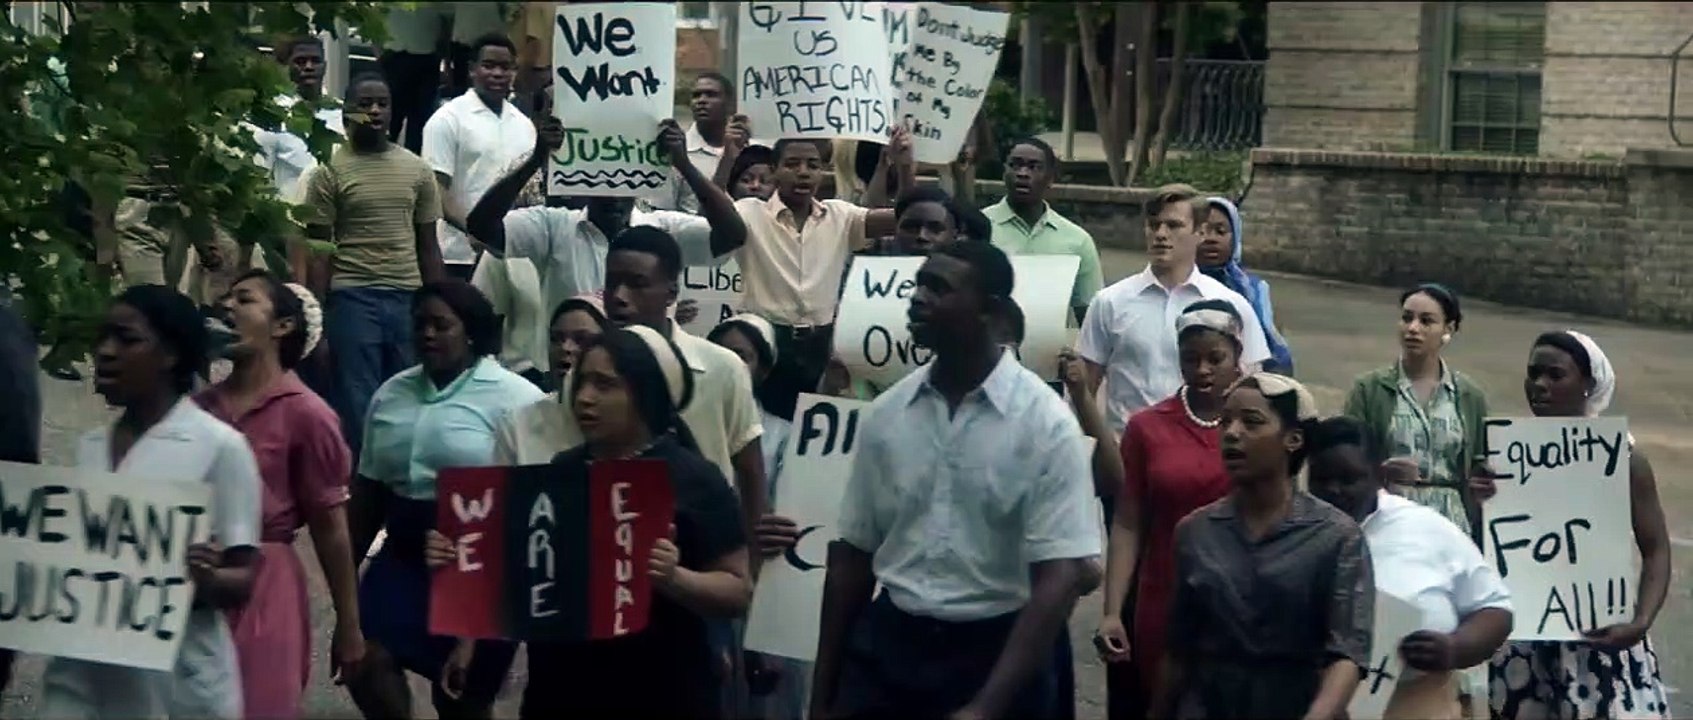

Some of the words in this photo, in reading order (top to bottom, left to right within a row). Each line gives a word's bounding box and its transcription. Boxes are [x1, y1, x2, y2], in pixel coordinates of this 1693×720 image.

[557, 12, 636, 57] We
[793, 29, 838, 56] US
[557, 62, 661, 102] Want
[743, 63, 881, 100] AMERICAN
[906, 67, 937, 88] the
[944, 79, 984, 98] Color
[864, 268, 917, 299] We
[1485, 420, 1622, 485] Equality
[0, 480, 69, 543] WE
[77, 488, 205, 564] WANT
[451, 488, 495, 572] WE
[1490, 515, 1591, 577] For
[528, 492, 560, 618] ARE
[0, 561, 186, 640] JUSTICE
